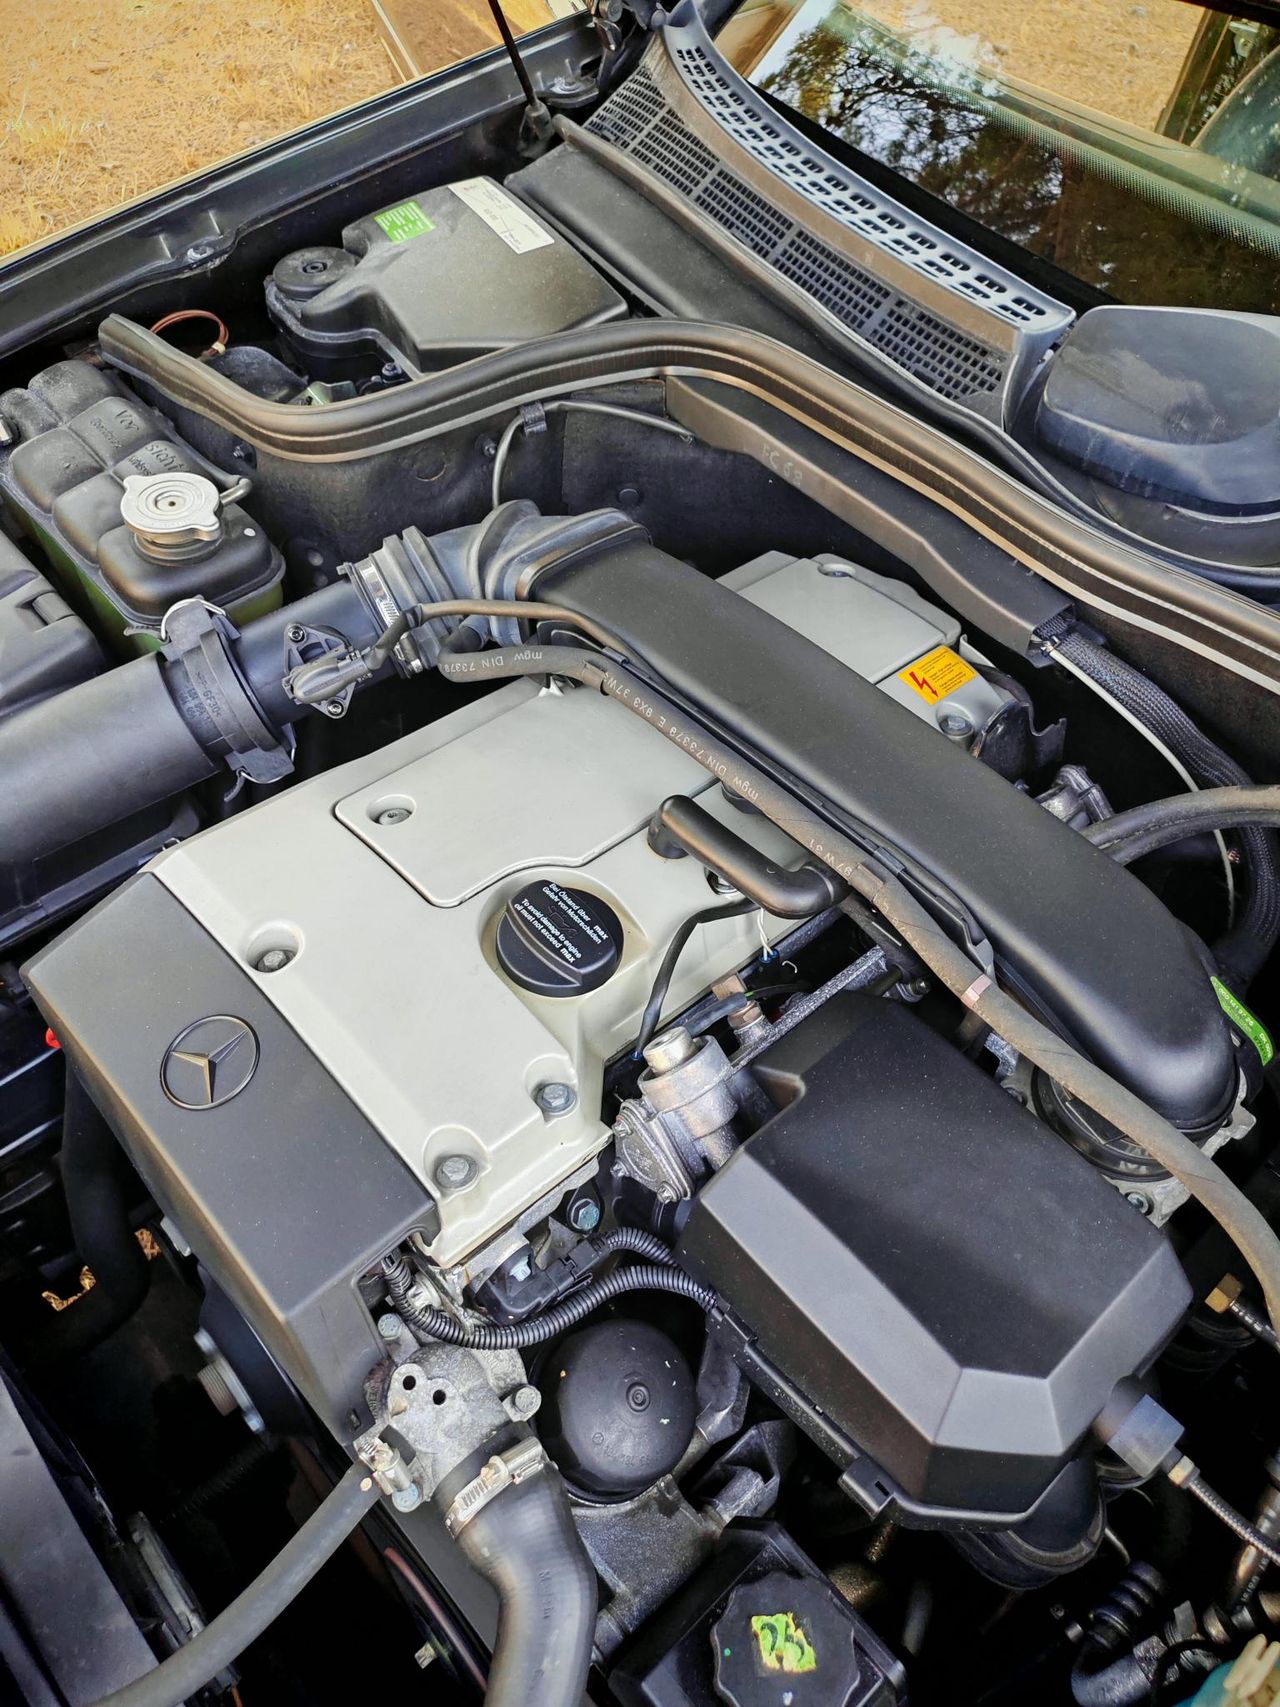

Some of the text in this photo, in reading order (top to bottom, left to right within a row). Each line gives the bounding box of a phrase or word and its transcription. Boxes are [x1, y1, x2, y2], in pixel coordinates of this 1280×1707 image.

[481, 656, 504, 669] DIN
[513, 650, 543, 661] mgw
[658, 715, 667, 728] E
[669, 726, 705, 760] 73378
[706, 755, 727, 777] DIN
[732, 776, 759, 801] mgw
[542, 886, 602, 944] Gefahr von Motorschäden
[549, 881, 561, 893] Bei
[593, 925, 608, 940] max
[514, 903, 576, 963] oil must not exceed max
[522, 898, 582, 959] To avoid damage to engine
